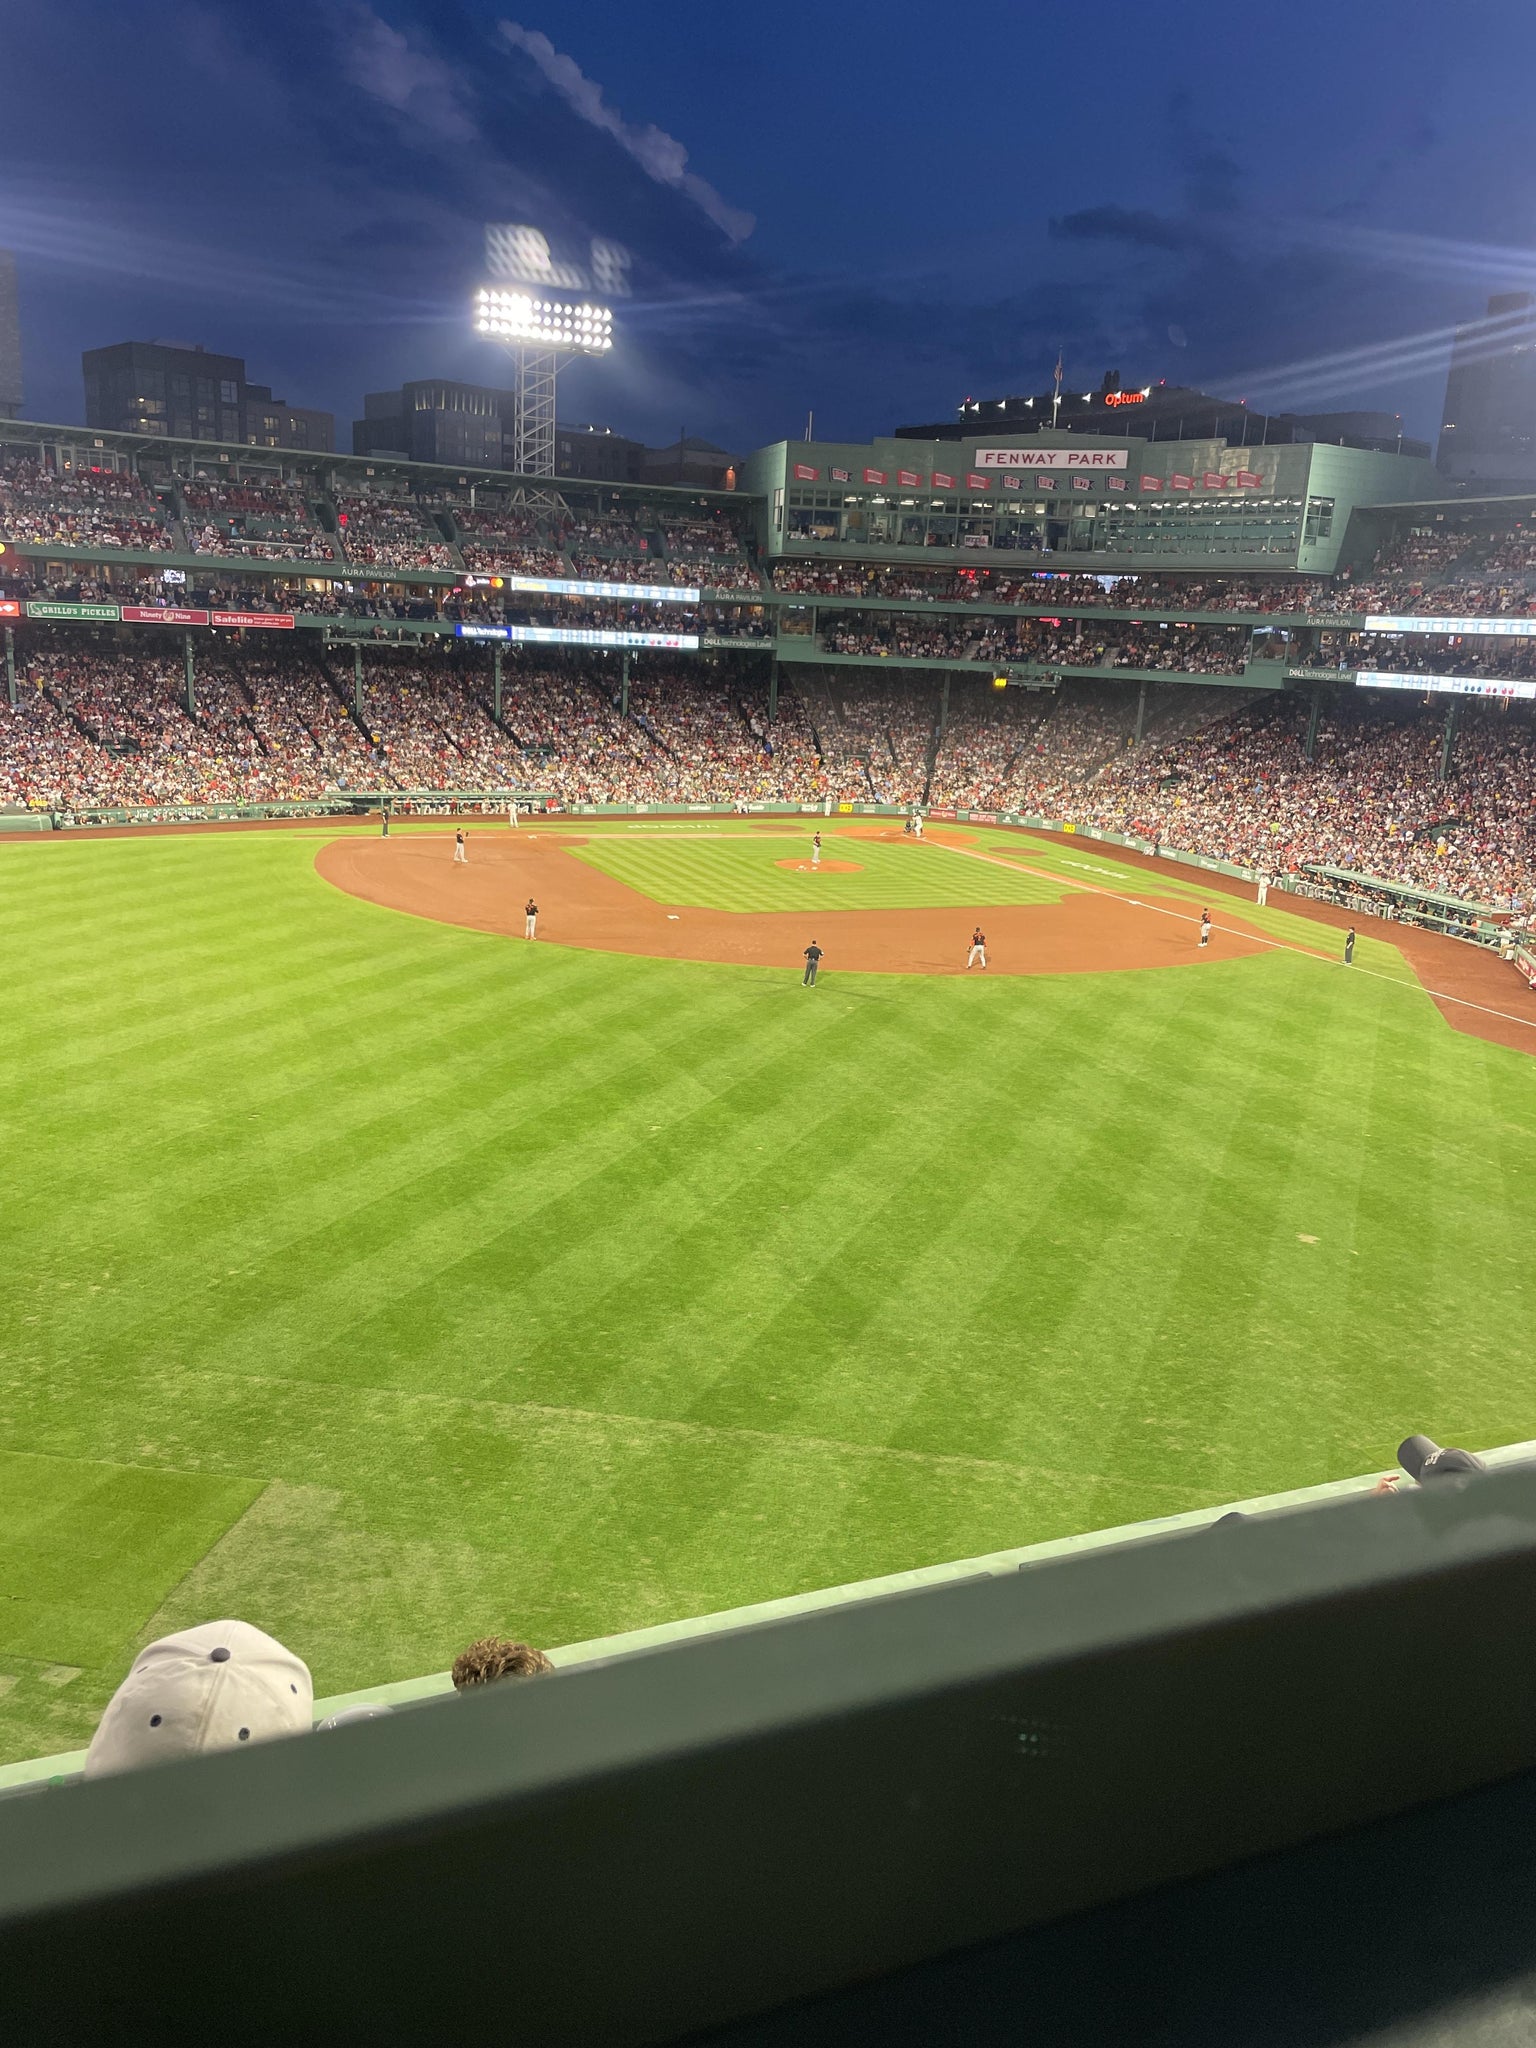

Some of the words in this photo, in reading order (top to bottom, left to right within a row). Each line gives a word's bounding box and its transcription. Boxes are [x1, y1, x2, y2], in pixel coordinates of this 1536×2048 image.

[1105, 393, 1144, 407] Optum
[985, 453, 1056, 464] FENWAY
[1068, 454, 1116, 464] PARK
[365, 569, 397, 579] PAVILION
[42, 606, 78, 615] GRILLO'S
[81, 607, 116, 617] PICKLES
[140, 611, 163, 620] Ninety
[175, 612, 192, 620] Nine
[214, 615, 254, 625] Safelite
[703, 638, 721, 646] DELL
[1289, 668, 1304, 677] DELL
